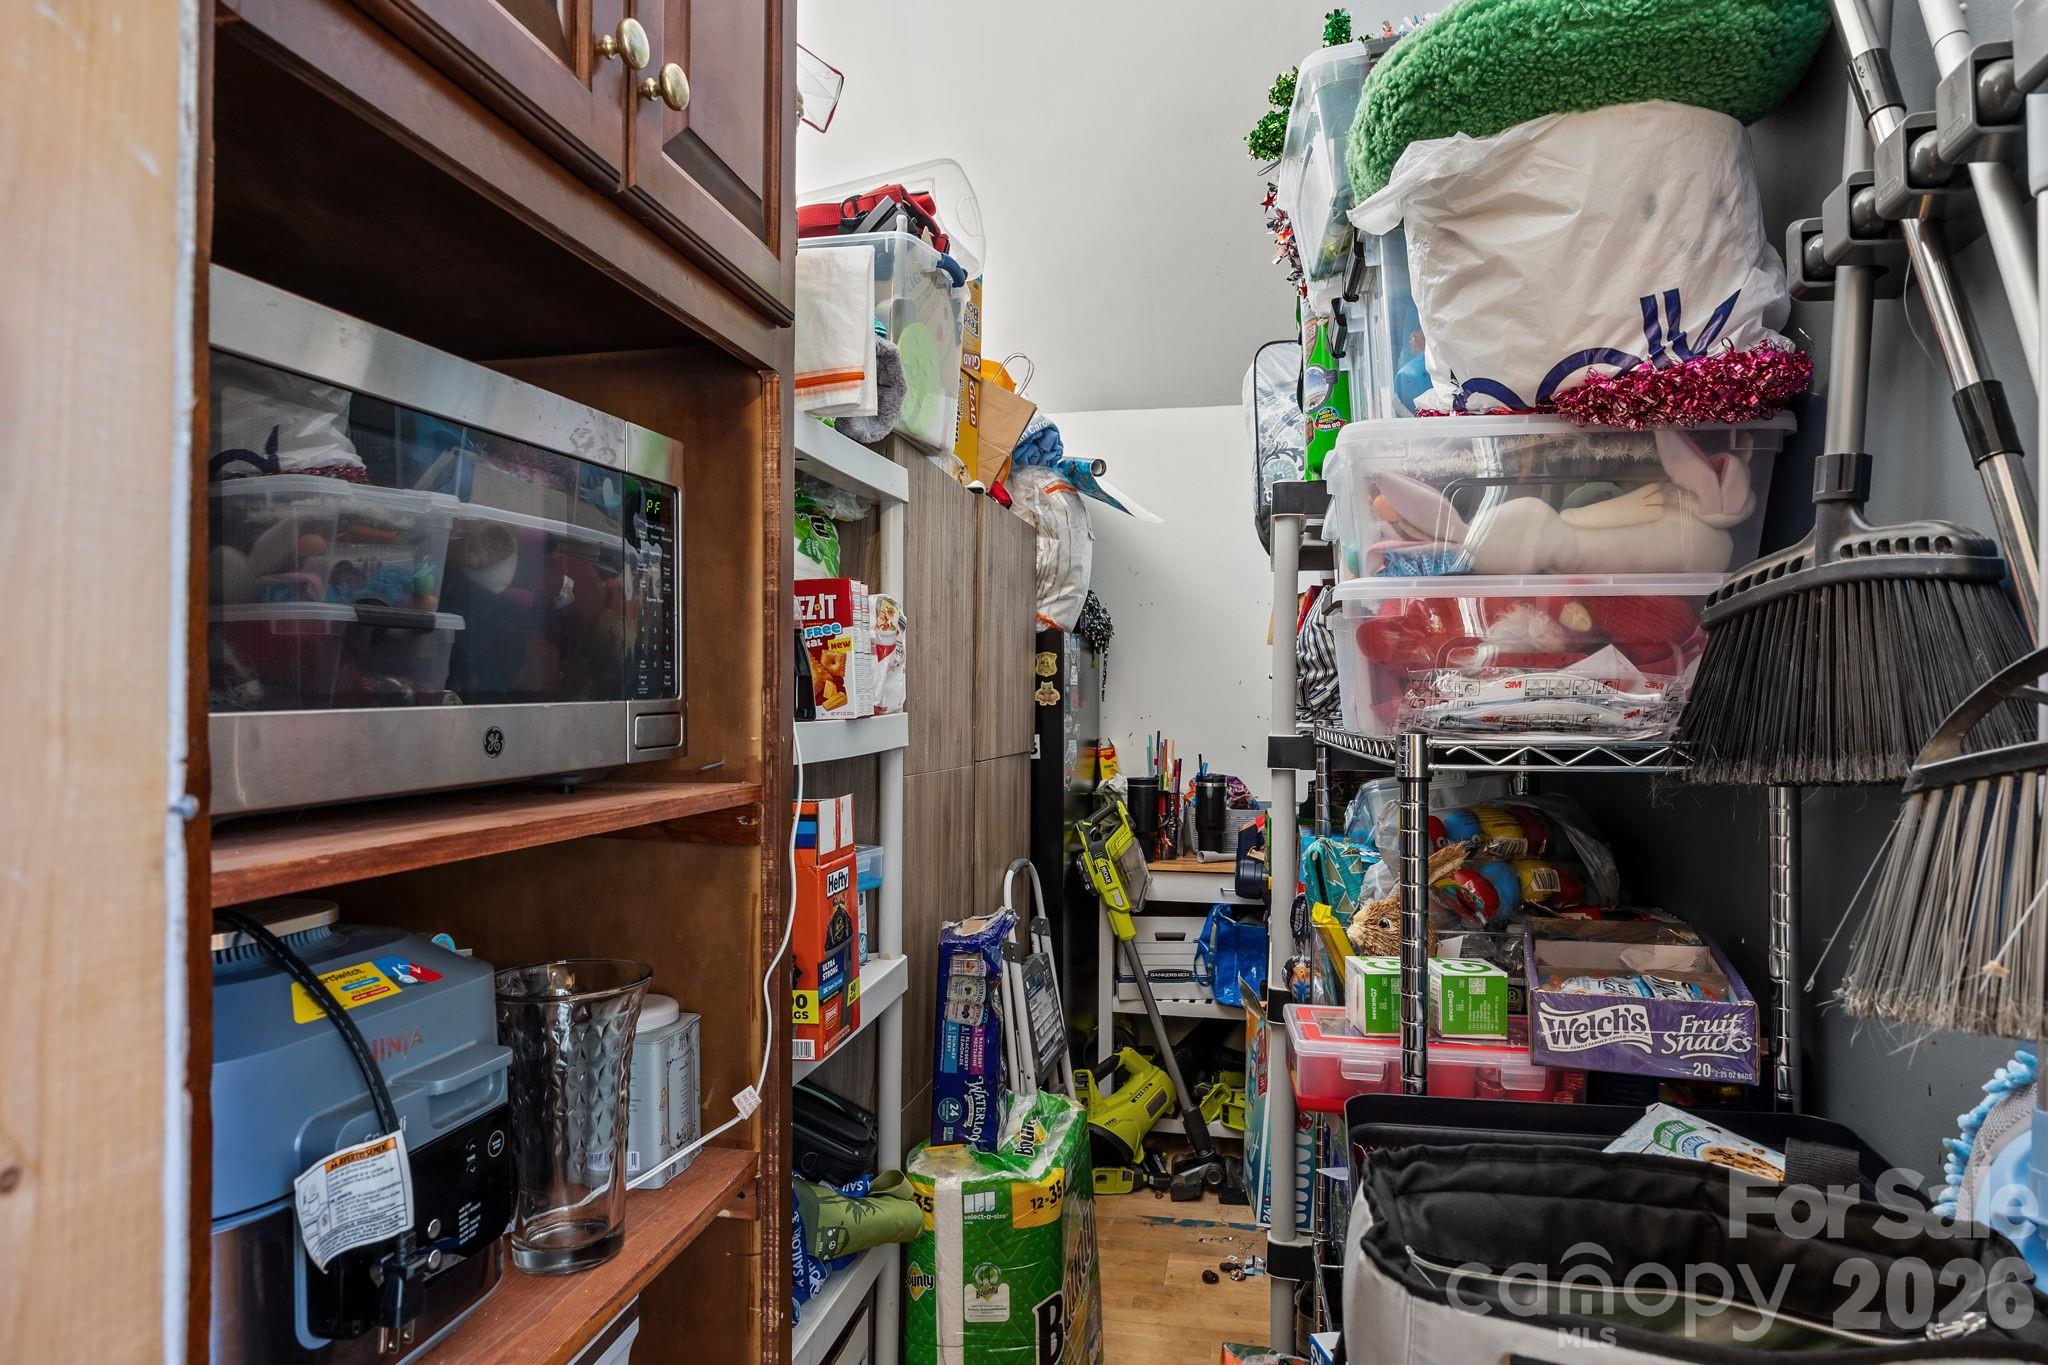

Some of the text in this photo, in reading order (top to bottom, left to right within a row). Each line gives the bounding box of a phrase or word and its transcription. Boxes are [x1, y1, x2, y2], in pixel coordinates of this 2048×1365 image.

[964, 353, 981, 370] GLAD
[969, 383, 977, 426] GLAD
[1505, 681, 1665, 690] 3M 3M
[1624, 709, 1641, 719] 3M
[828, 868, 849, 893] Hefty
[822, 958, 836, 972] ULTRA
[822, 965, 839, 981] STRONG
[793, 994, 808, 1009] 0
[794, 1011, 809, 1019] GS
[1543, 1008, 1647, 1046] Welch's
[1680, 1013, 1743, 1035] Fruit
[1571, 1034, 1628, 1051] FAMILY FARMER OWNED
[1661, 1031, 1752, 1055] Snacks
[1693, 1062, 1711, 1078] 20
[1737, 1072, 1753, 1081] BAGS
[950, 1103, 959, 1117] 24
[964, 1075, 990, 1143] WATERLOO
[975, 1285, 999, 1300] Bounty
